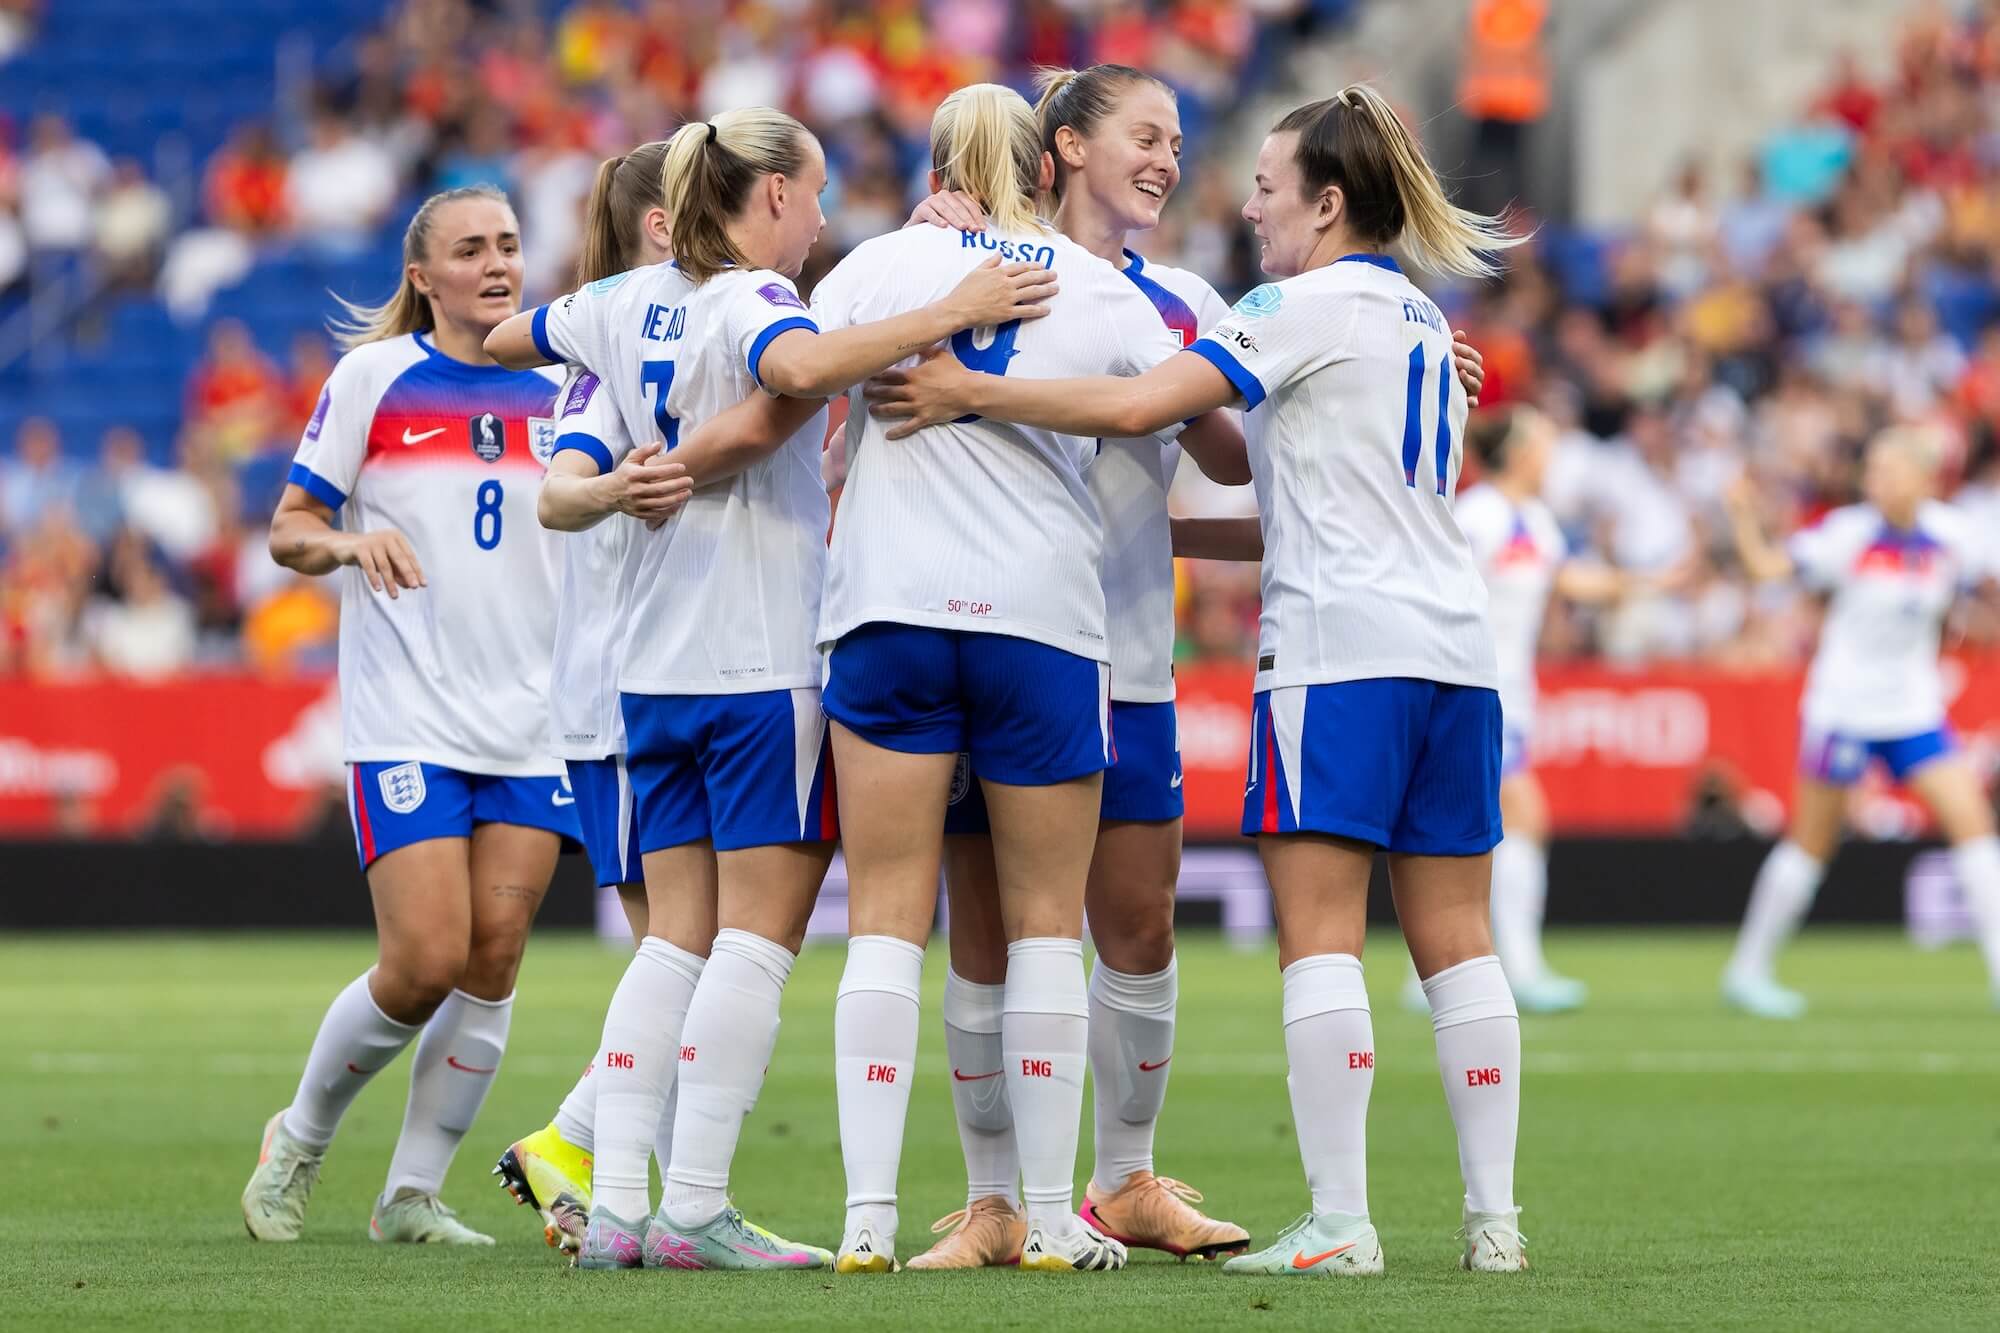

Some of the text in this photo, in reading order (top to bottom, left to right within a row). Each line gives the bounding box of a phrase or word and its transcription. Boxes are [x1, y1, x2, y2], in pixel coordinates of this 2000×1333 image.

[640, 360, 681, 453] 7
[1402, 340, 1452, 498] 11
[473, 479, 505, 552] 8
[970, 602, 992, 616] CAP
[607, 1052, 635, 1070] ENG
[1022, 1059, 1053, 1078] ENG
[1348, 1052, 1374, 1070] ENG
[866, 1064, 897, 1084] ENG
[1466, 1067, 1502, 1088] ENG
